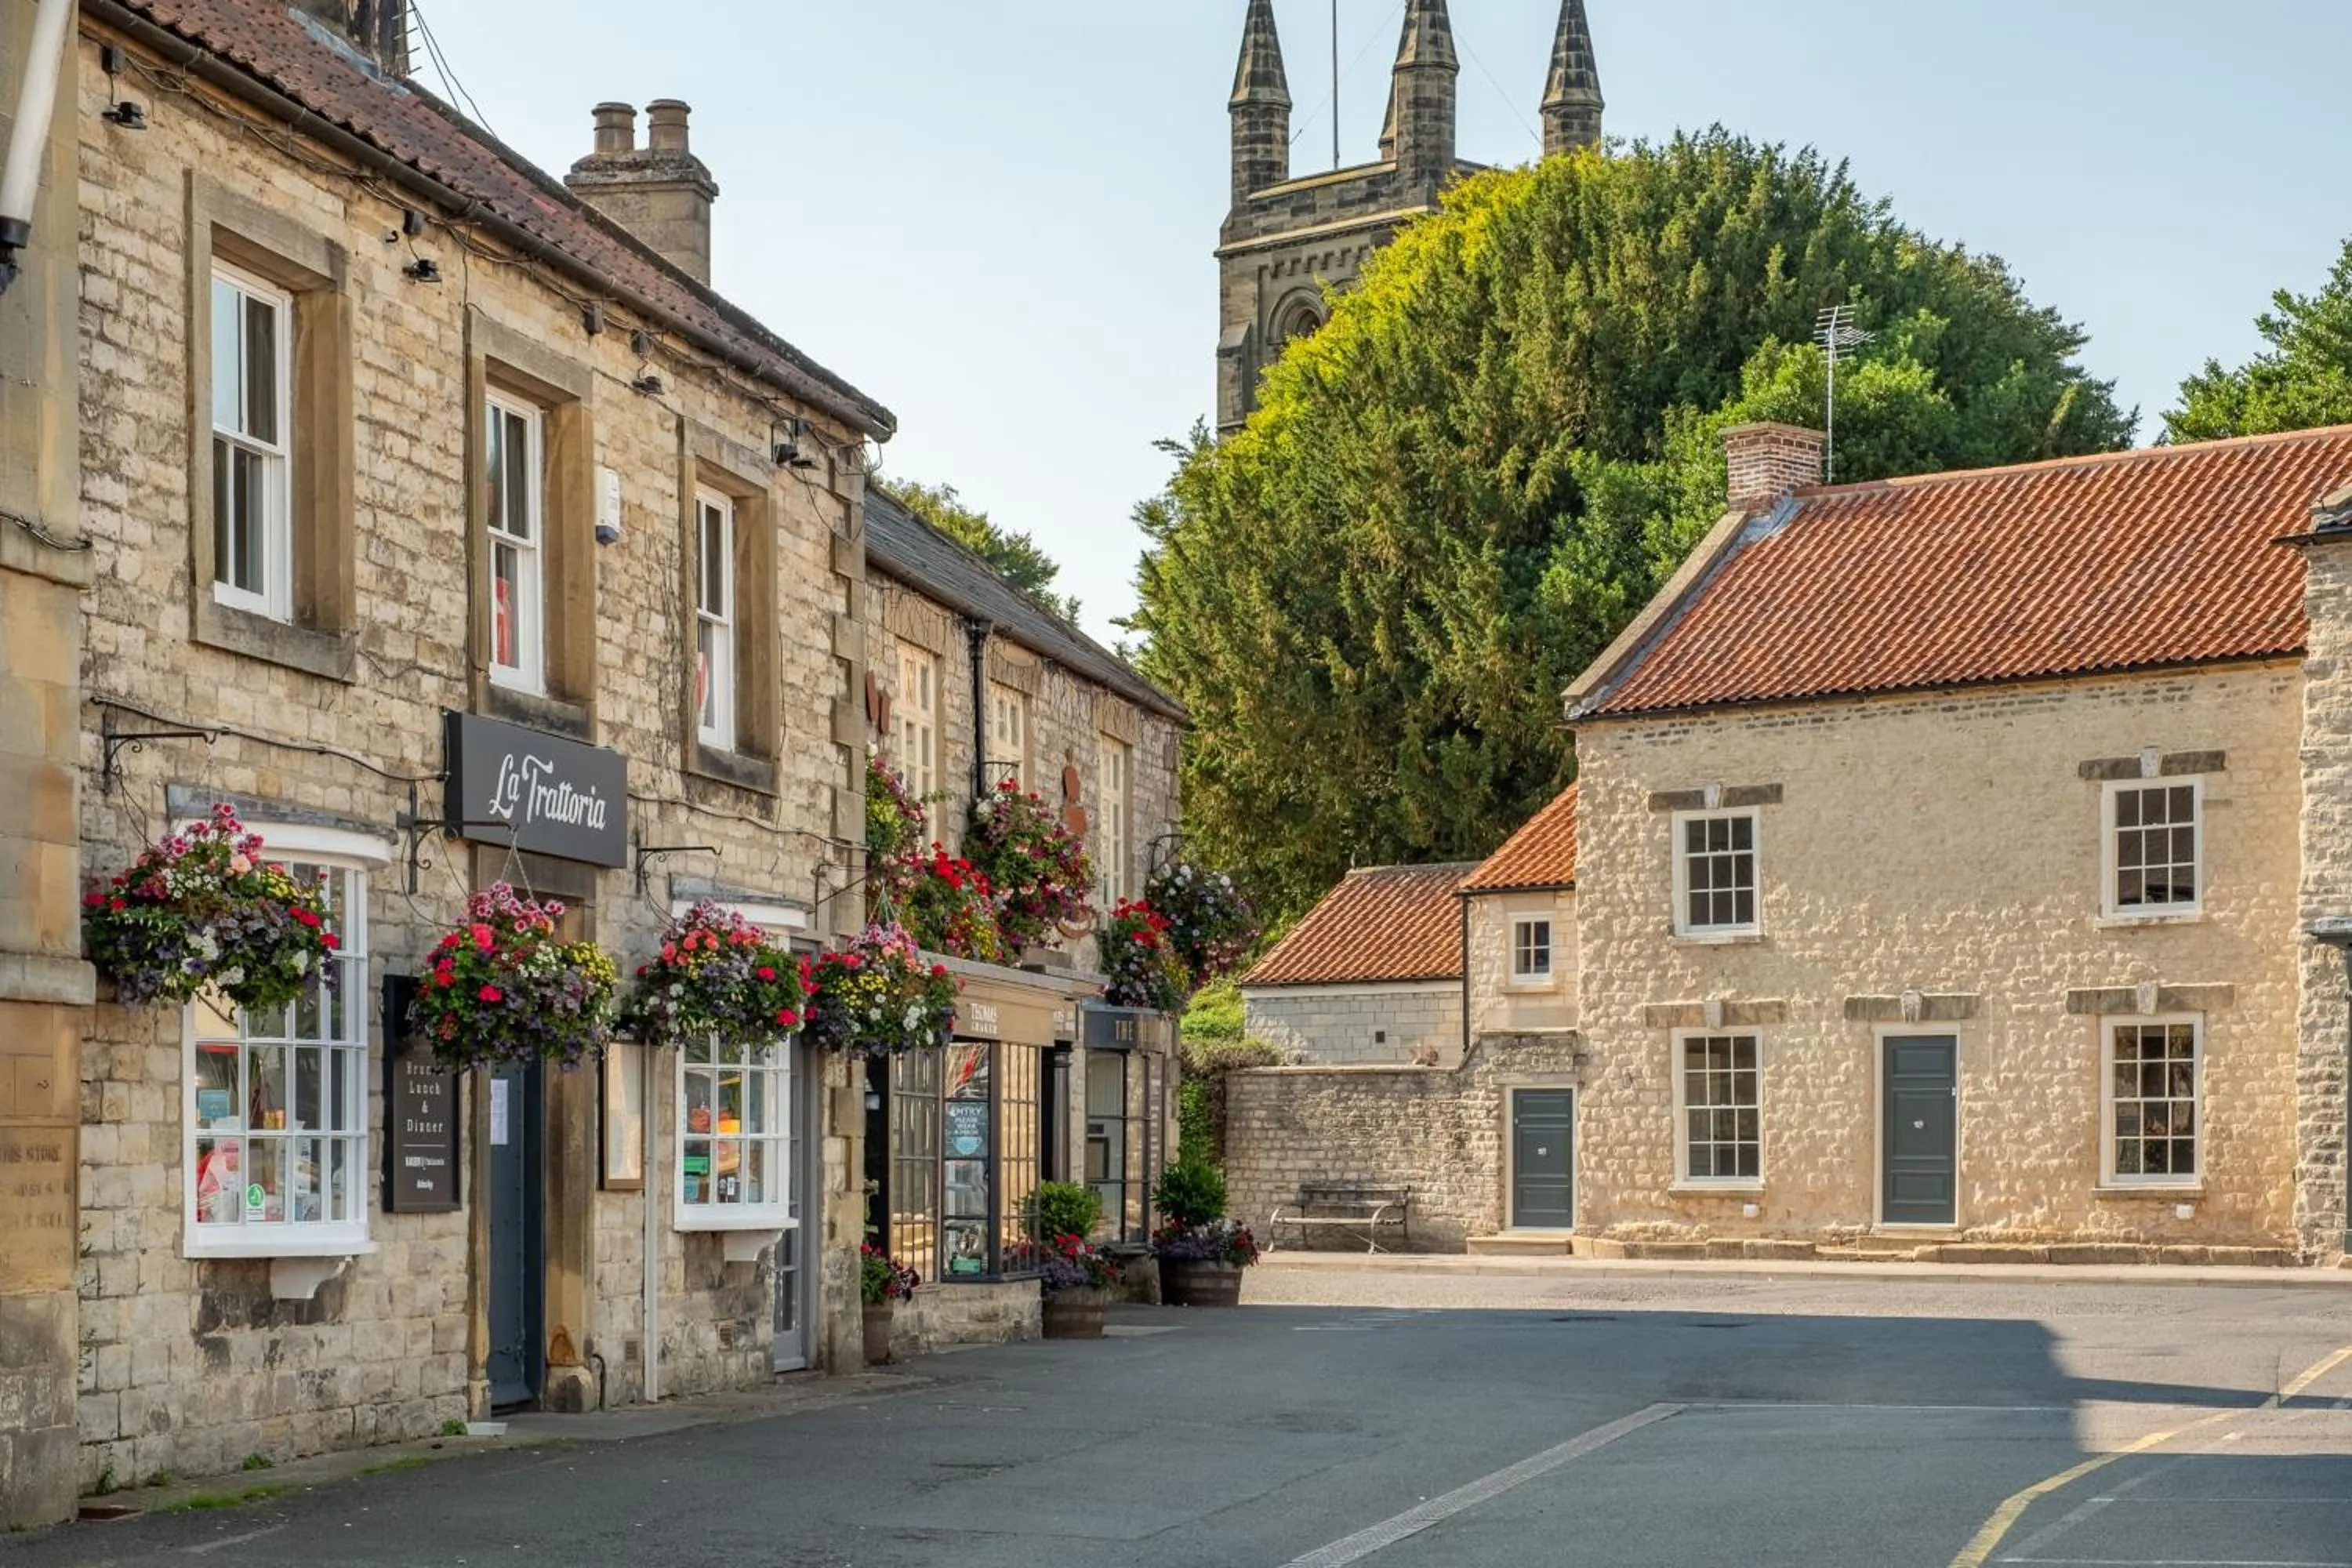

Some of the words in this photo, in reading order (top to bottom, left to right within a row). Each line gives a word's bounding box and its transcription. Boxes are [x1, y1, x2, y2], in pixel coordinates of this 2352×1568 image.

[489, 753, 521, 819] La
[521, 754, 607, 831] Trattoria
[406, 1061, 445, 1076] Brun
[408, 1080, 441, 1096] Lunch
[420, 1100, 429, 1114] &
[406, 1119, 444, 1134] Dinner
